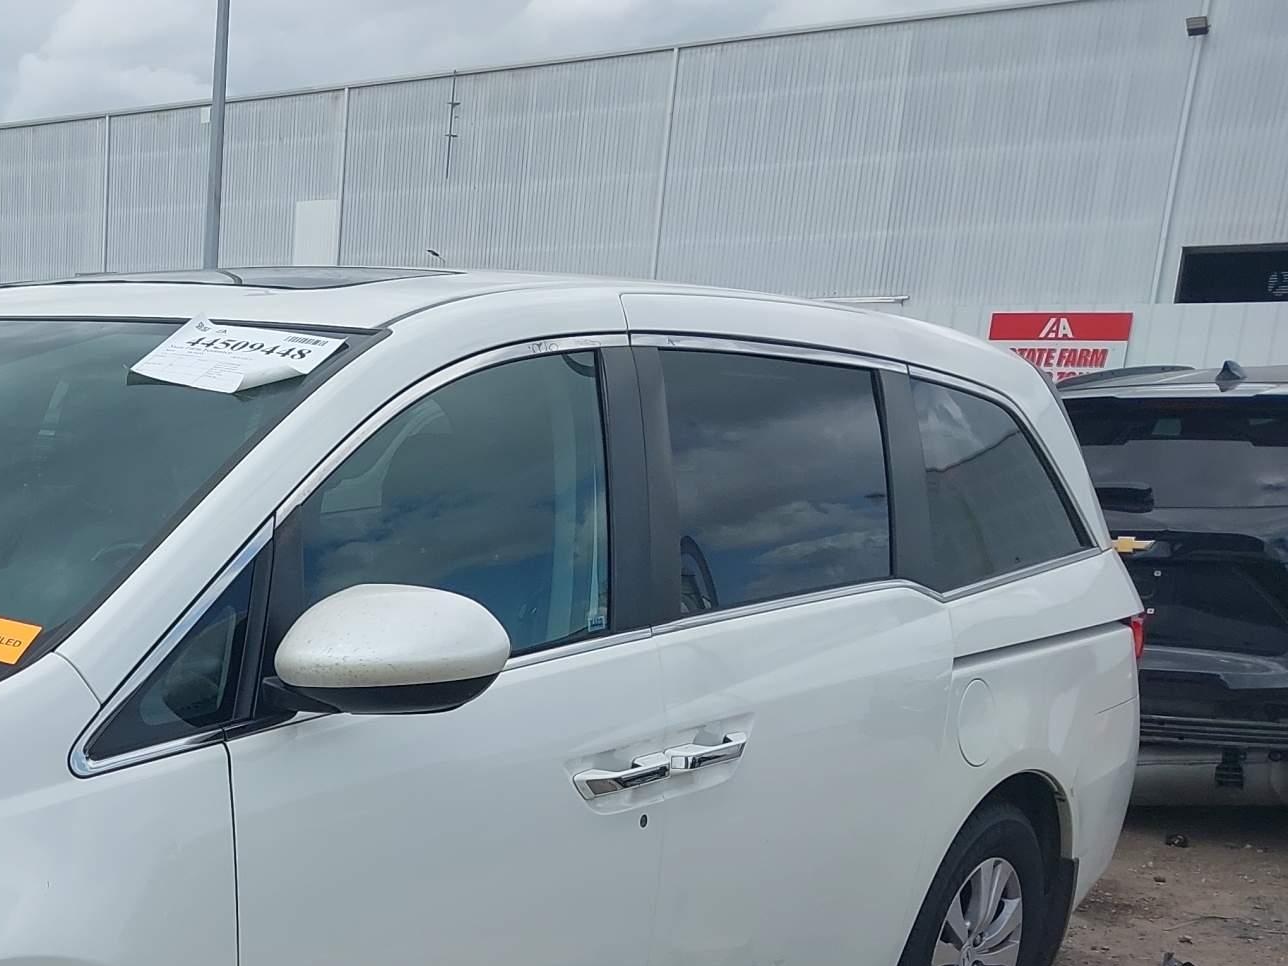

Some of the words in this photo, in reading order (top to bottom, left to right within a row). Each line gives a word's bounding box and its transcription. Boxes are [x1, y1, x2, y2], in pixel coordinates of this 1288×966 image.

[185, 336, 312, 360] 44509448
[1011, 347, 1056, 368] TATE
[1056, 348, 1109, 368] FARM
